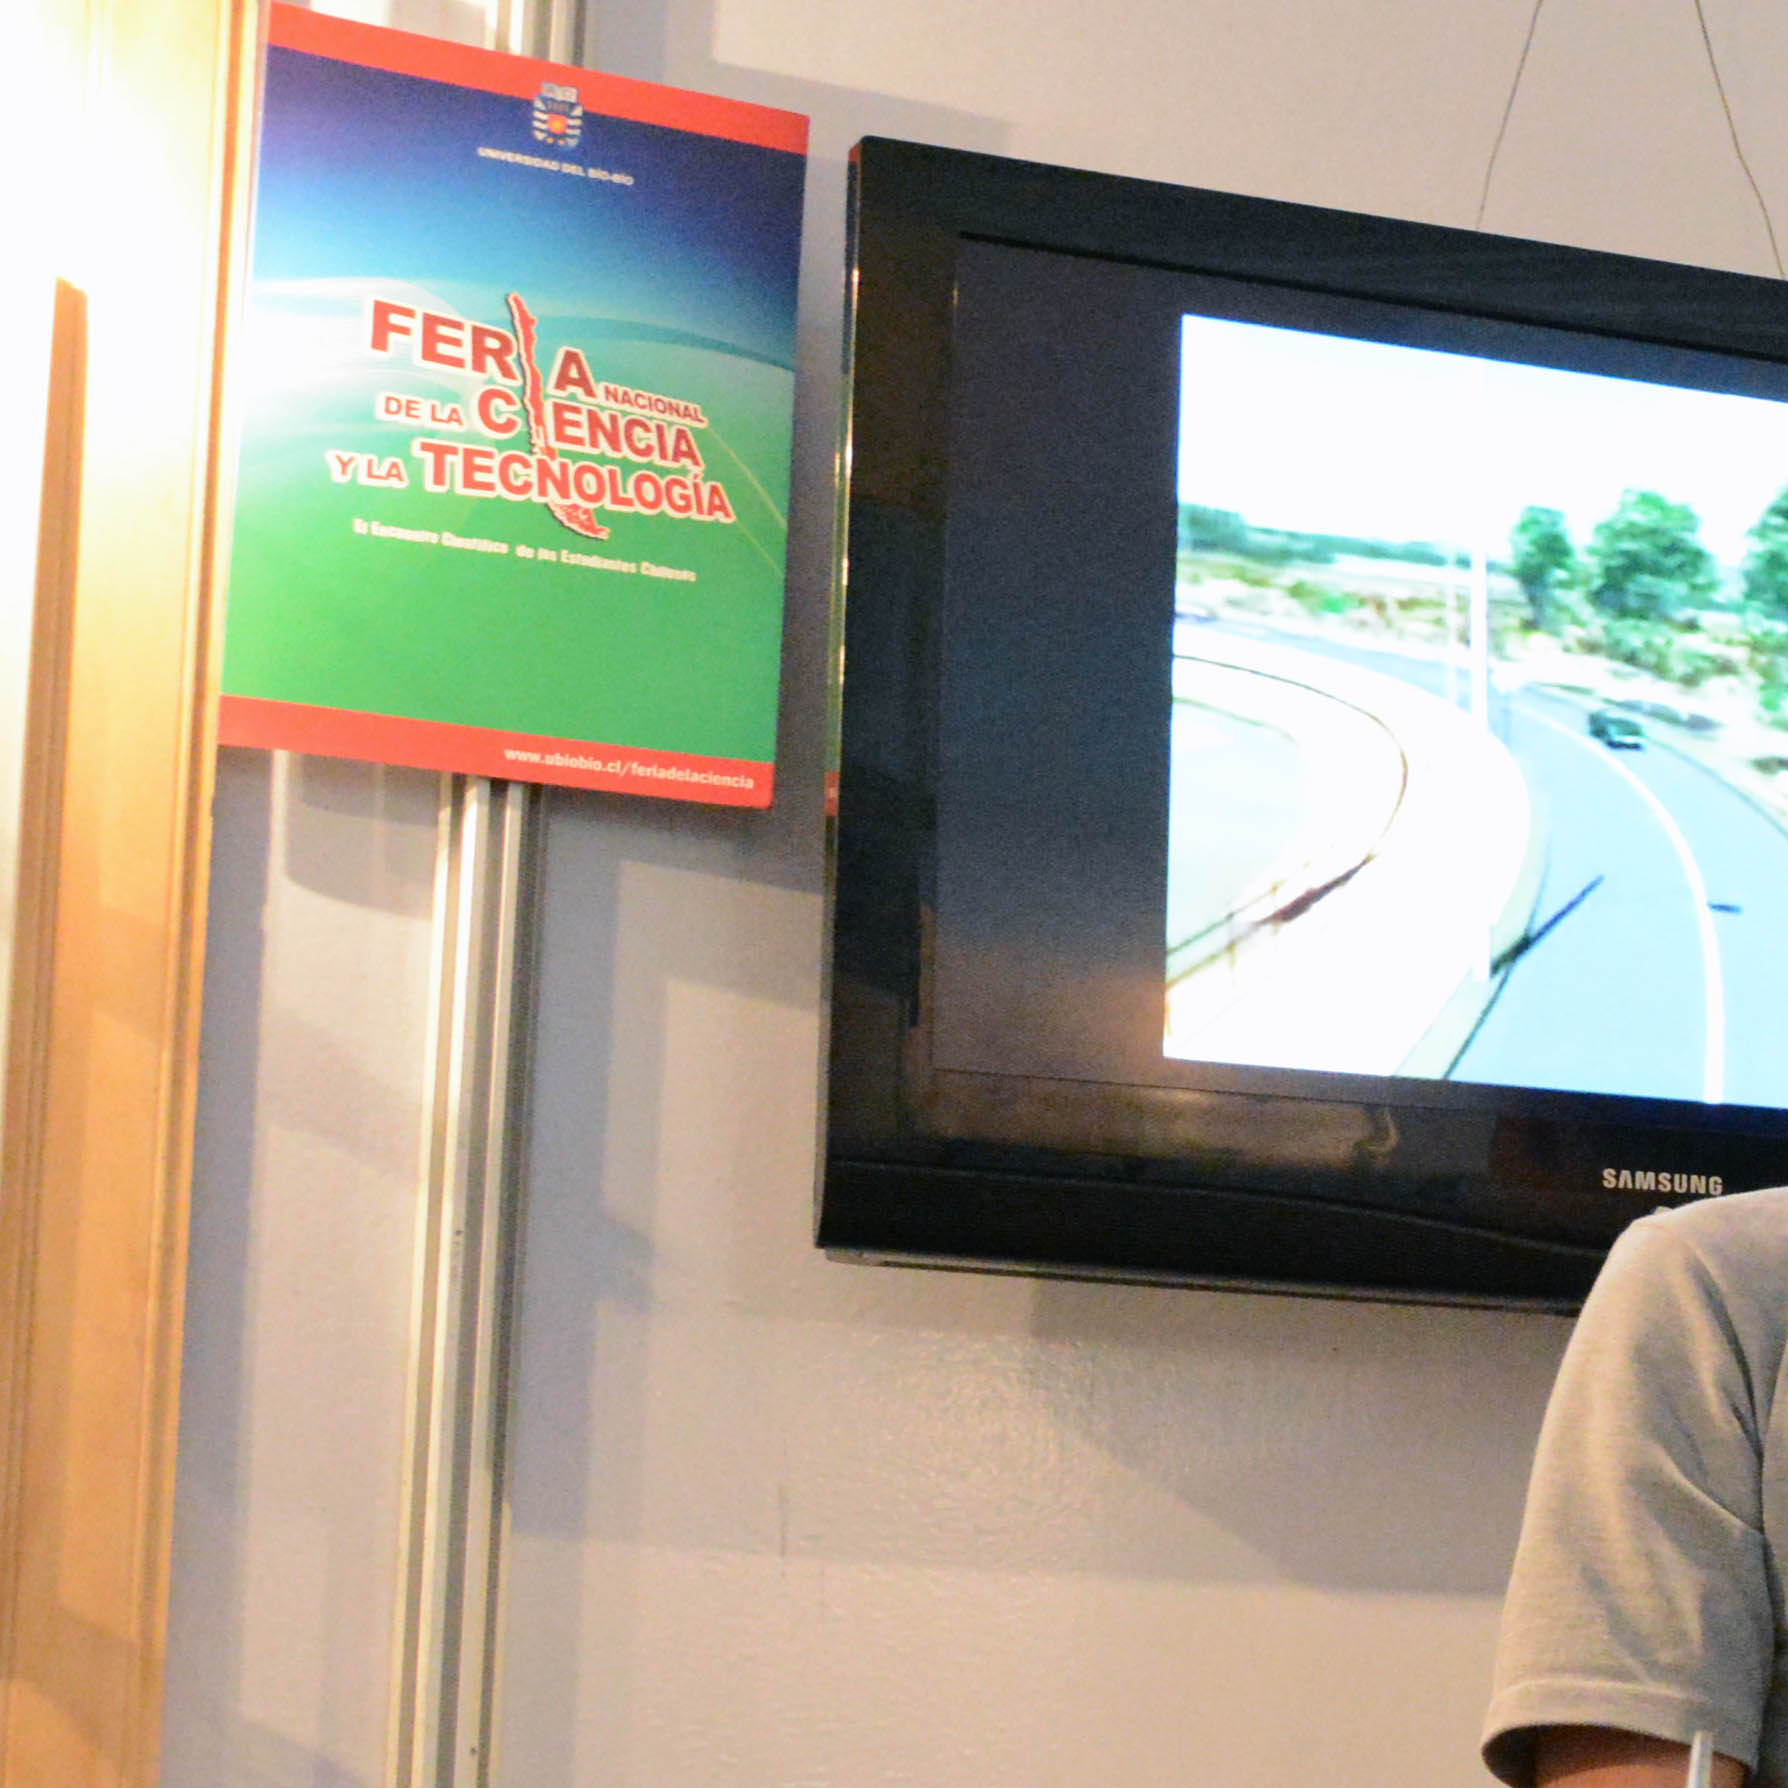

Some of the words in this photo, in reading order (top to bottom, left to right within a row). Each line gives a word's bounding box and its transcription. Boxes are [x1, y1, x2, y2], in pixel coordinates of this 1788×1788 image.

[477, 147, 560, 171] UNIVERSIDAD
[561, 162, 586, 177] DEL
[384, 396, 421, 419] DE
[431, 403, 464, 426] LA
[603, 384, 705, 424] NACIONAL
[336, 454, 356, 476] Y
[367, 459, 405, 482] LA
[420, 441, 732, 519] TECNOLOGÍA
[560, 550, 637, 574] Estudiantes
[504, 748, 755, 789] www.ubiobio.cl/feriadelaciencia
[1602, 1167, 1723, 1196] SAMSUNG
